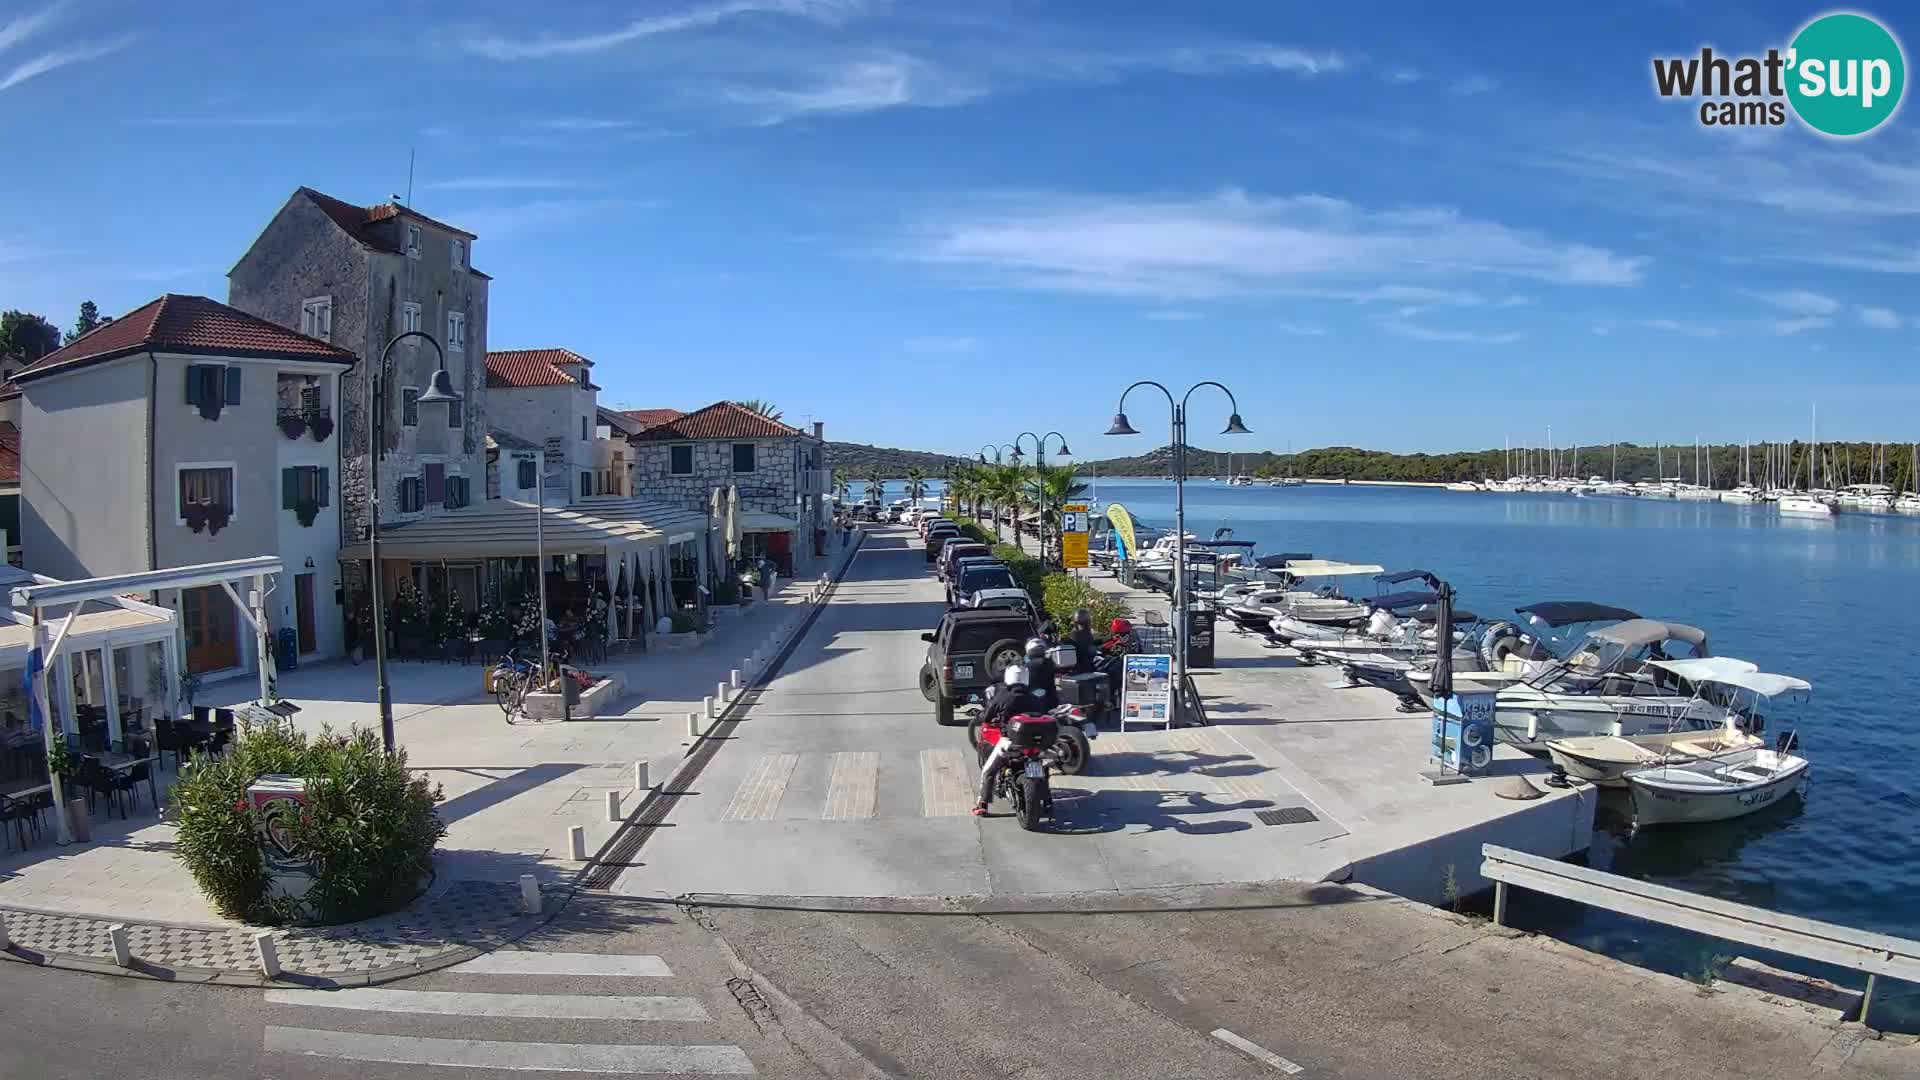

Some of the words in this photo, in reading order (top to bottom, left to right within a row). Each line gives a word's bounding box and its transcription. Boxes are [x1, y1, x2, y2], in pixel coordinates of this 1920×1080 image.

[1065, 514, 1075, 530] P
[1463, 703, 1494, 713] RENT
[1646, 705, 1665, 715] RENT
